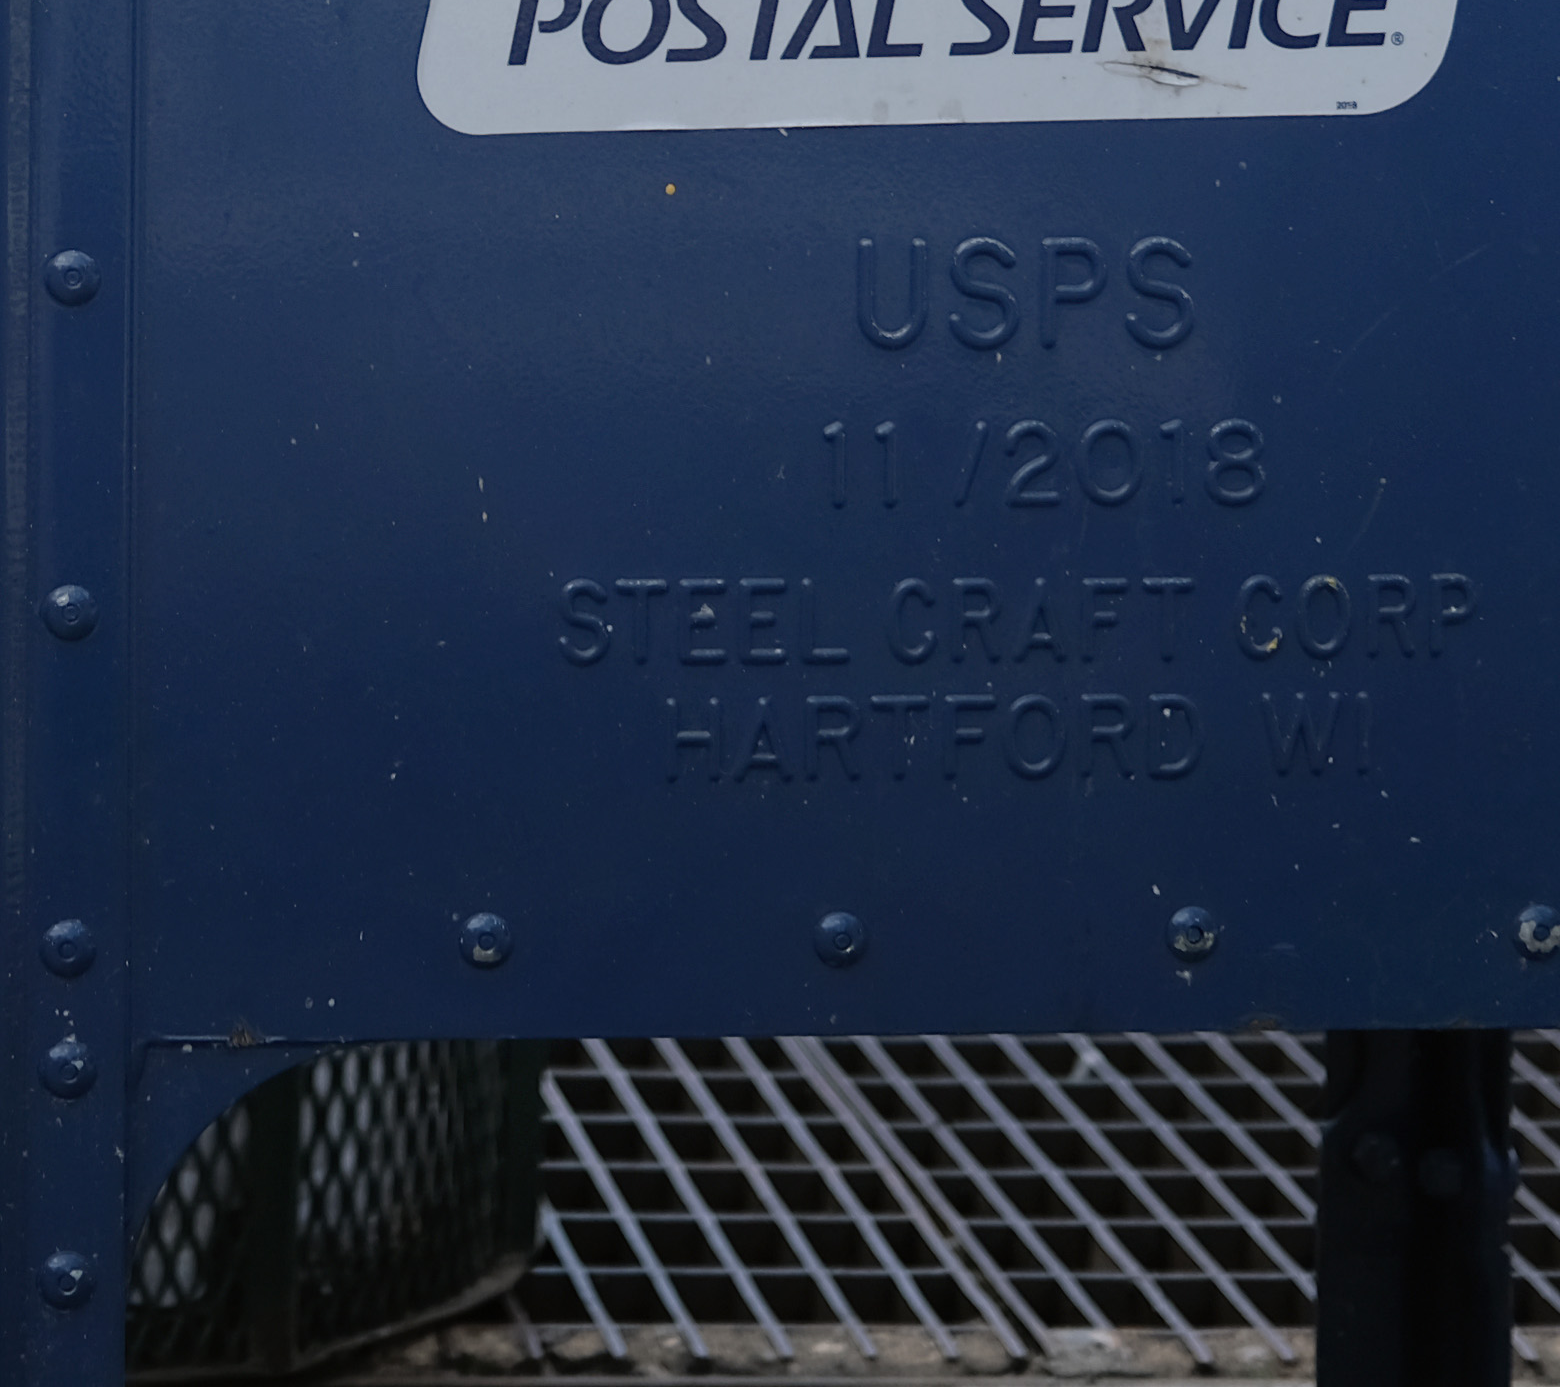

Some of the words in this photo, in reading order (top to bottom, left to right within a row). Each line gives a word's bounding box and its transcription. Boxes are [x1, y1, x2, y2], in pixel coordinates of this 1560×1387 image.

[857, 235, 1196, 351] USPS
[557, 576, 852, 667] STEEL
[885, 575, 1198, 666] CRAFT
[1237, 572, 1477, 664] CORP
[665, 690, 1206, 783] HARTFORD
[1258, 688, 1375, 778] WI
